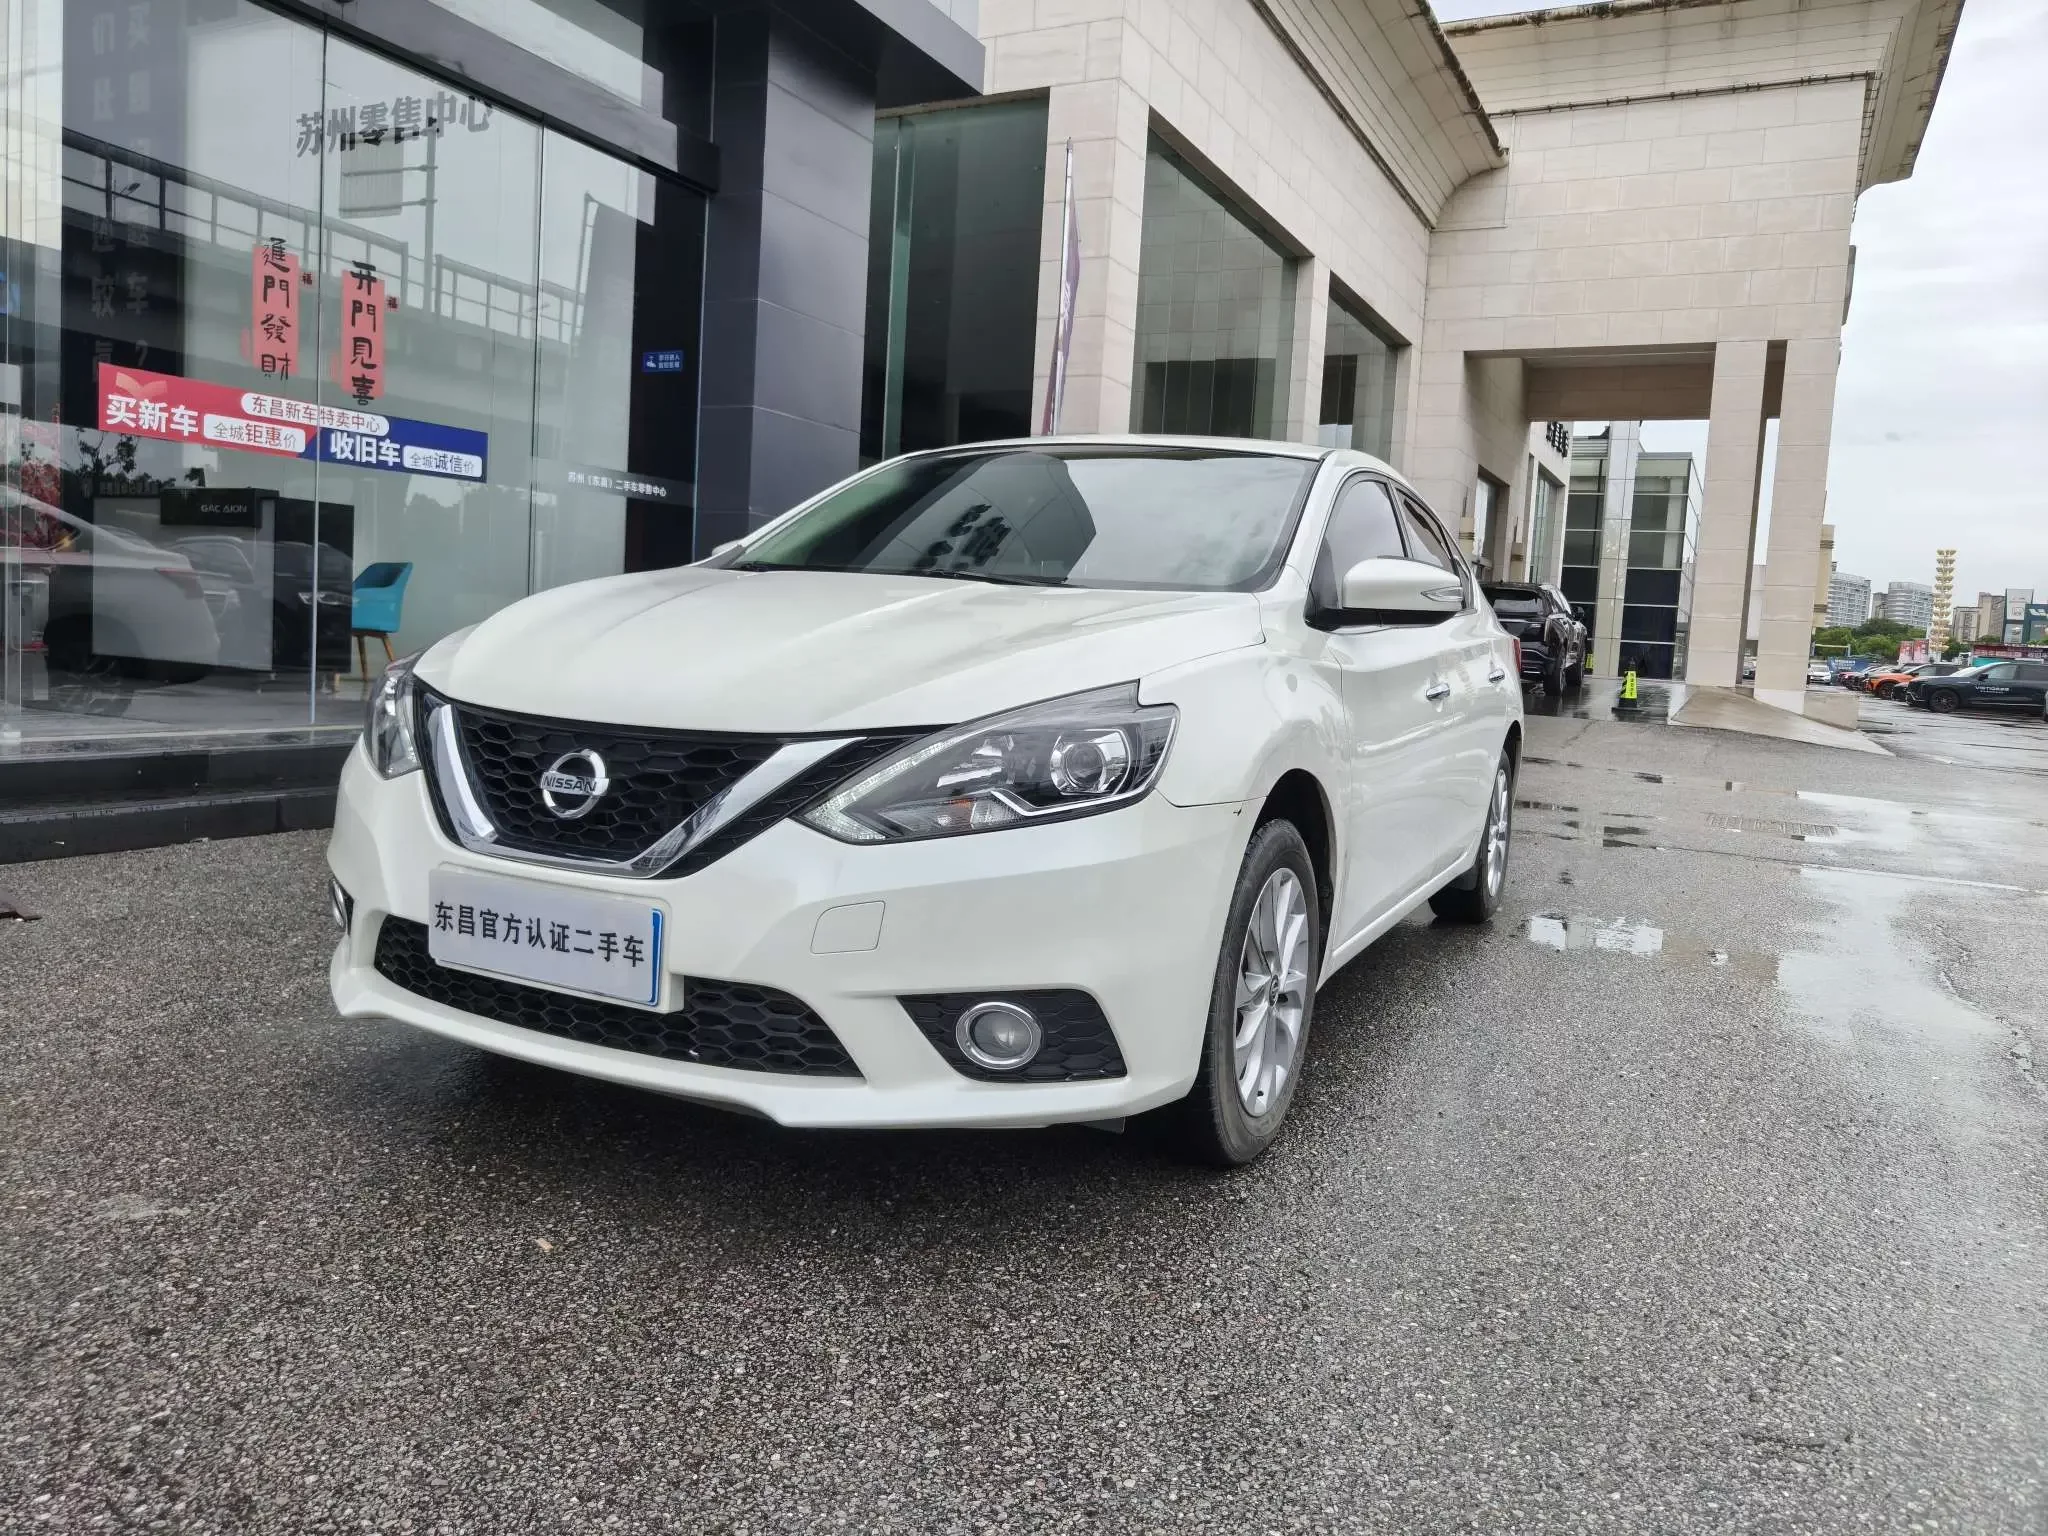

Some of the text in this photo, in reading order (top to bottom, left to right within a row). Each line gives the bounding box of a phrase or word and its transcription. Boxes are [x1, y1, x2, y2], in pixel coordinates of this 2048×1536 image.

[296, 91, 493, 158] 苏州零售中心
[106, 393, 199, 437] 买新车
[251, 396, 381, 434] 东昌新车特卖中心
[213, 422, 298, 450] 全城钜惠价
[330, 430, 401, 467] 收旧车
[409, 451, 475, 475] 全城诚信价
[200, 504, 221, 513] GAC
[543, 774, 598, 793] NISSAN
[434, 901, 645, 968] 东昌官方认证二手车
